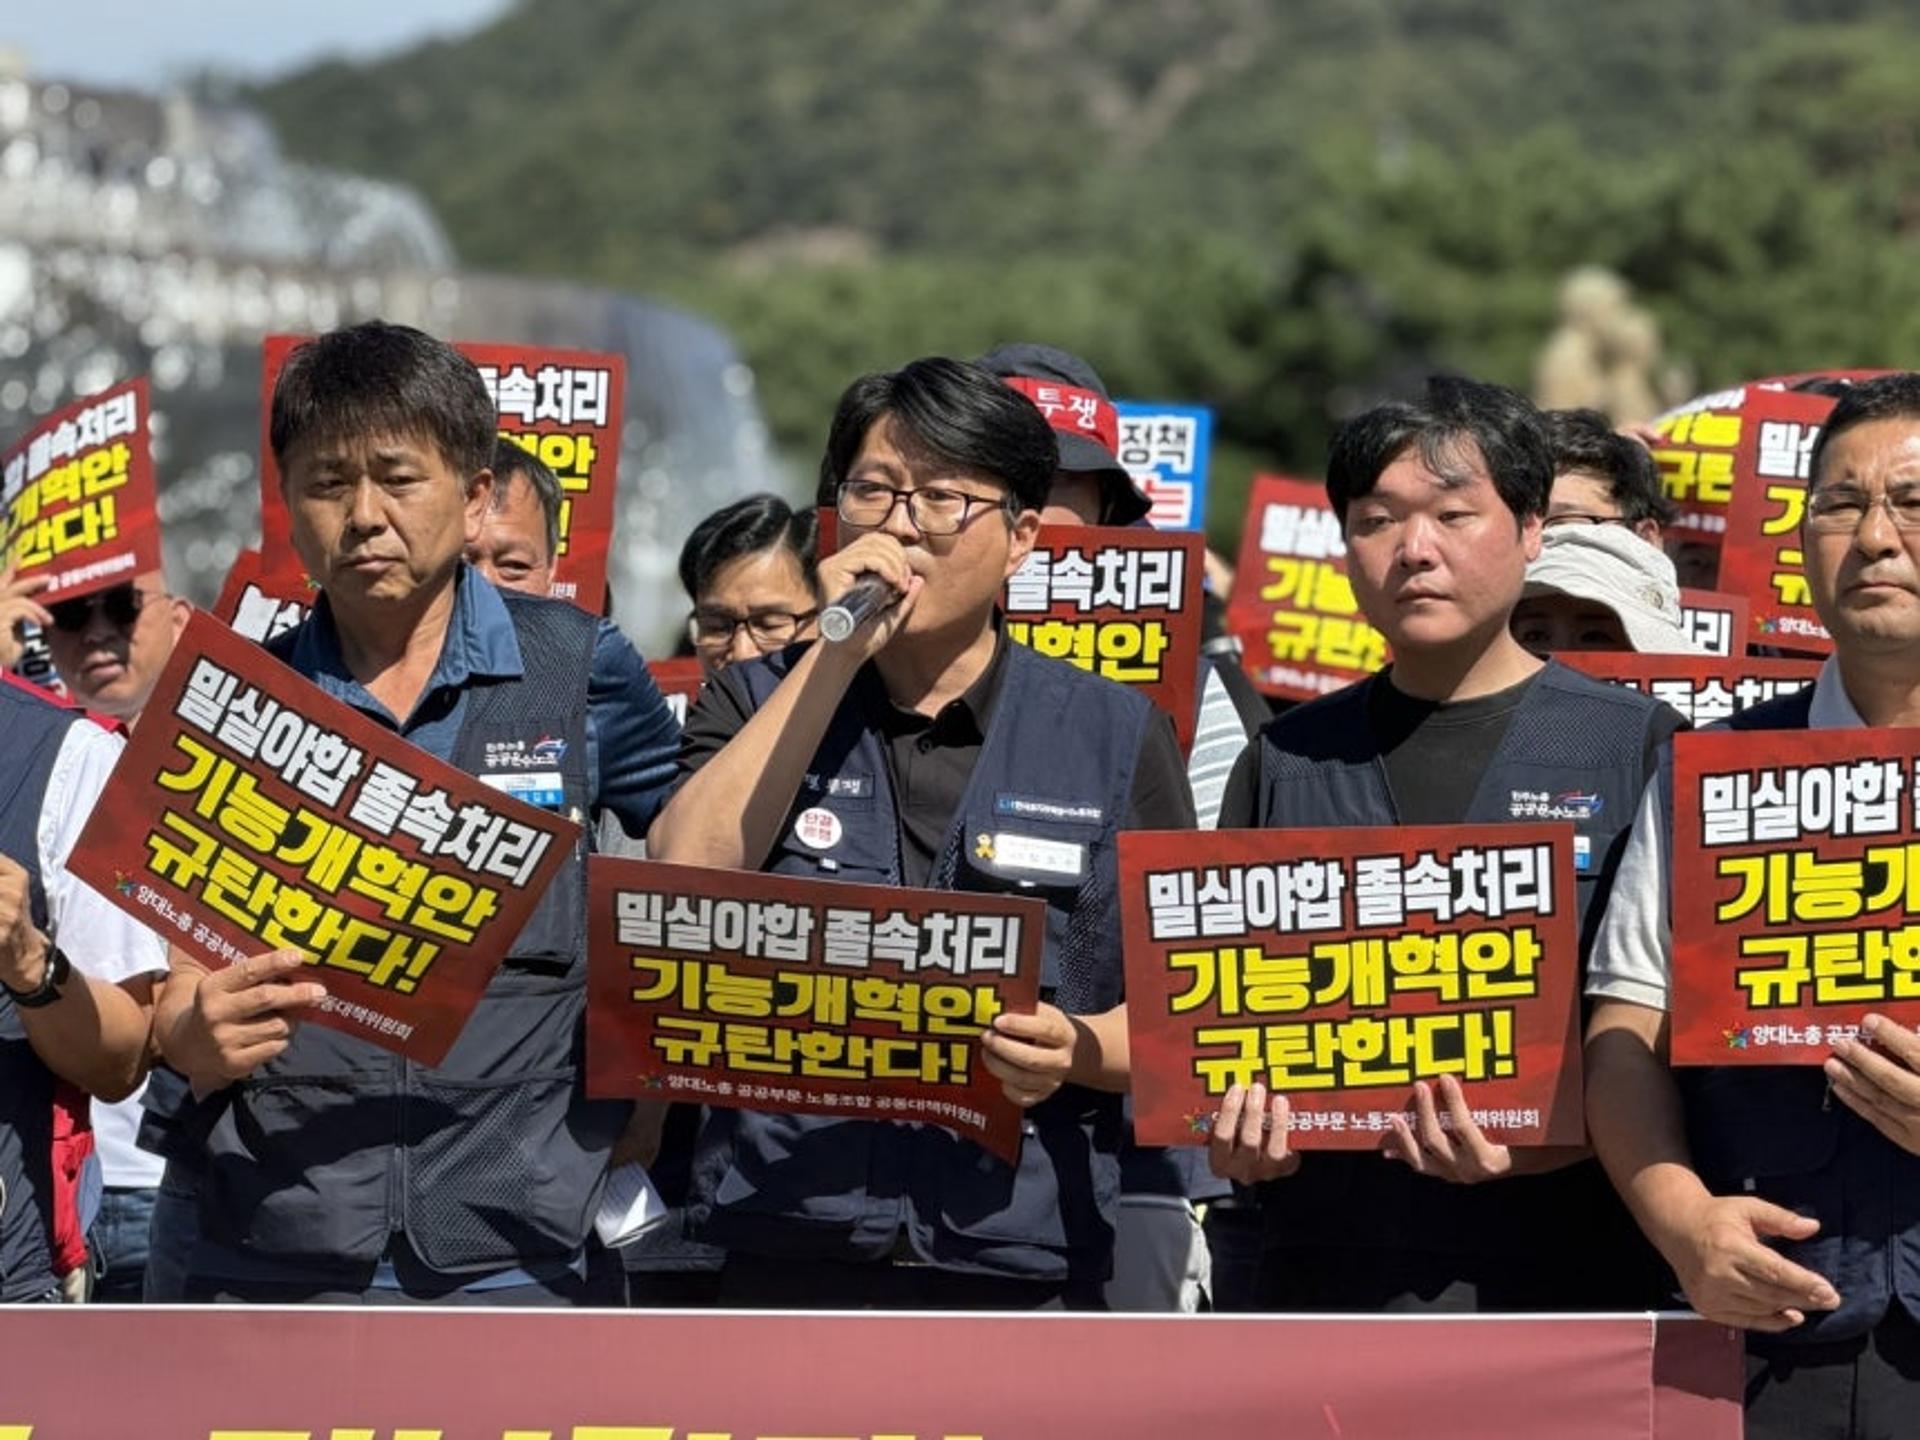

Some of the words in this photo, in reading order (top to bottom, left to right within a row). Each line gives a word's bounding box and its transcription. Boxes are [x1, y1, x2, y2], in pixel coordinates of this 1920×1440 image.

[1036, 387, 1097, 429] 투쟁
[1121, 423, 1187, 465] 정책
[1008, 549, 1184, 611] 졸속처리
[176, 657, 363, 807] 밀실야합
[349, 763, 554, 886] 졸속처리
[1703, 761, 1903, 844] 밀실야합
[158, 734, 498, 944] 기능개혁안
[137, 885, 193, 932] 양대노총
[146, 812, 440, 993] 규란한다!
[1148, 861, 1345, 939] 밀실야합
[1354, 846, 1553, 926] 졸속처리
[617, 893, 816, 961] 밀실야합
[824, 909, 1021, 975] 졸속처리
[1169, 928, 1541, 1014] 기능개혁안
[632, 957, 1003, 1036] 기능개혁안
[1752, 1025, 1823, 1046] 양대노총
[654, 1017, 970, 1084] 규란한다!
[1196, 1010, 1514, 1094] 규란한다!
[737, 1083, 803, 1103] 공공부문
